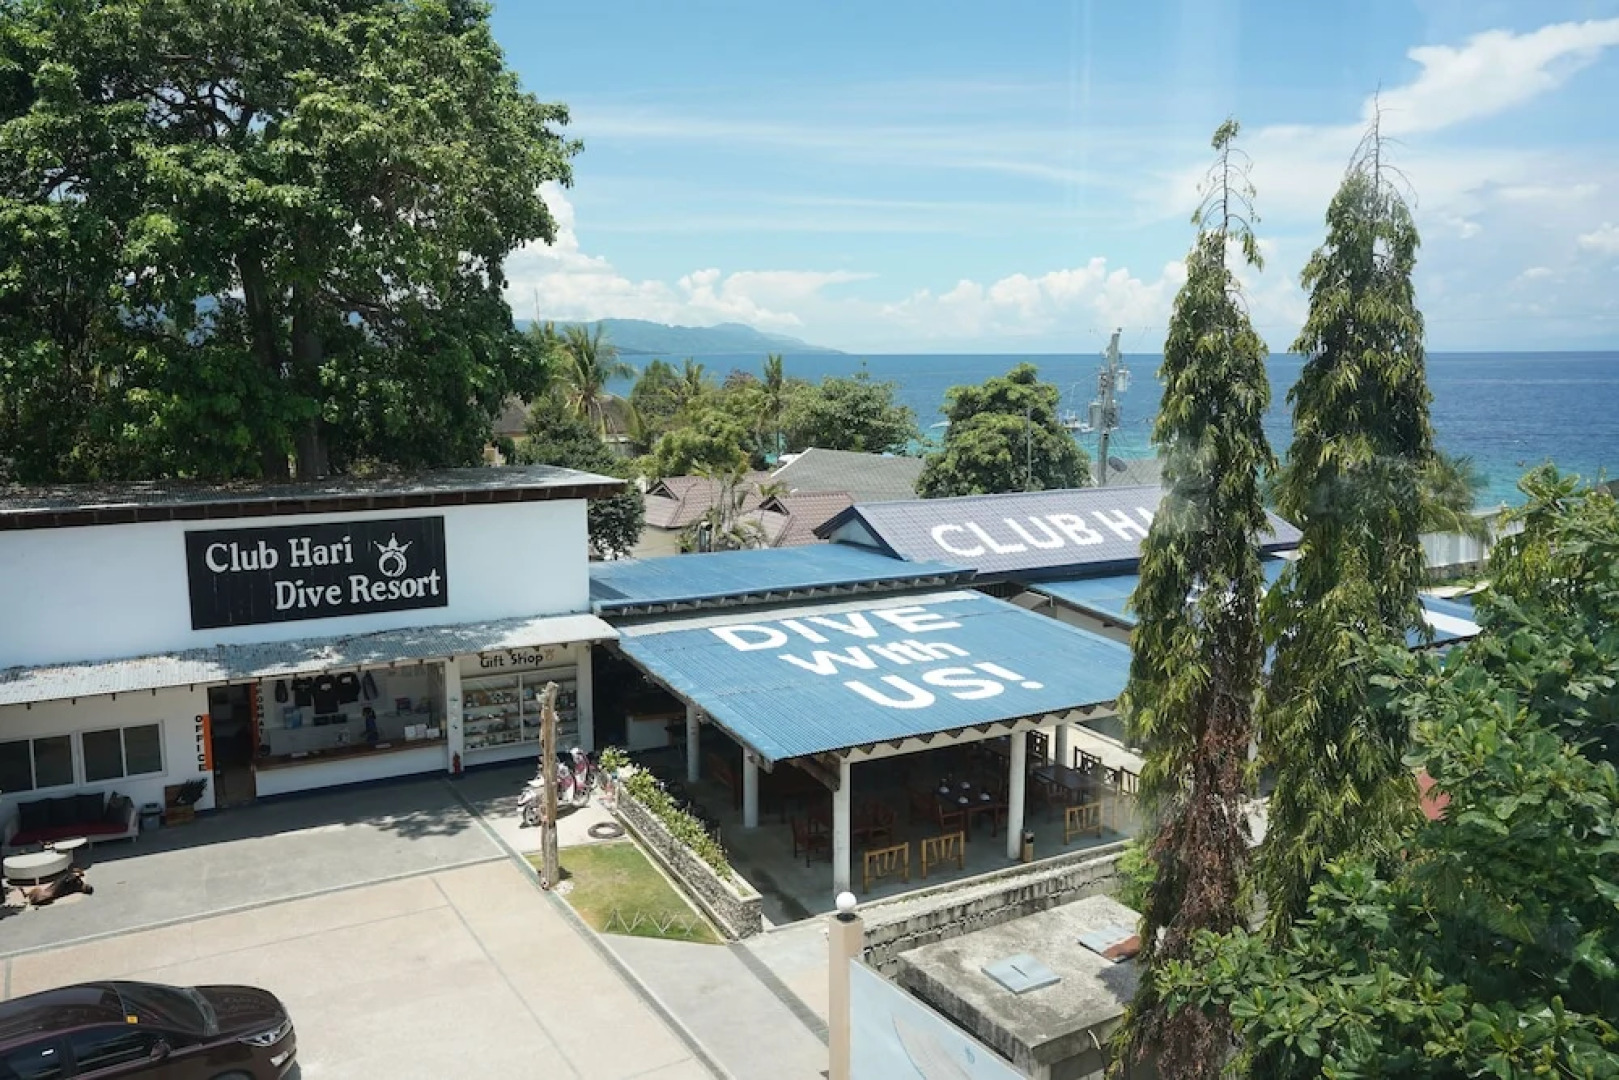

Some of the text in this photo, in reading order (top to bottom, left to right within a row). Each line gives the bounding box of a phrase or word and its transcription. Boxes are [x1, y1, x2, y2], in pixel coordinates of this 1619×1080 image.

[205, 535, 354, 573] Club Hari
[931, 512, 1104, 557] CLUB
[274, 568, 441, 610] Dive Resort
[708, 606, 964, 651] DIVE
[480, 651, 544, 668] Gift Shop
[843, 661, 1044, 709] US!
[195, 715, 207, 772] OFFICE
